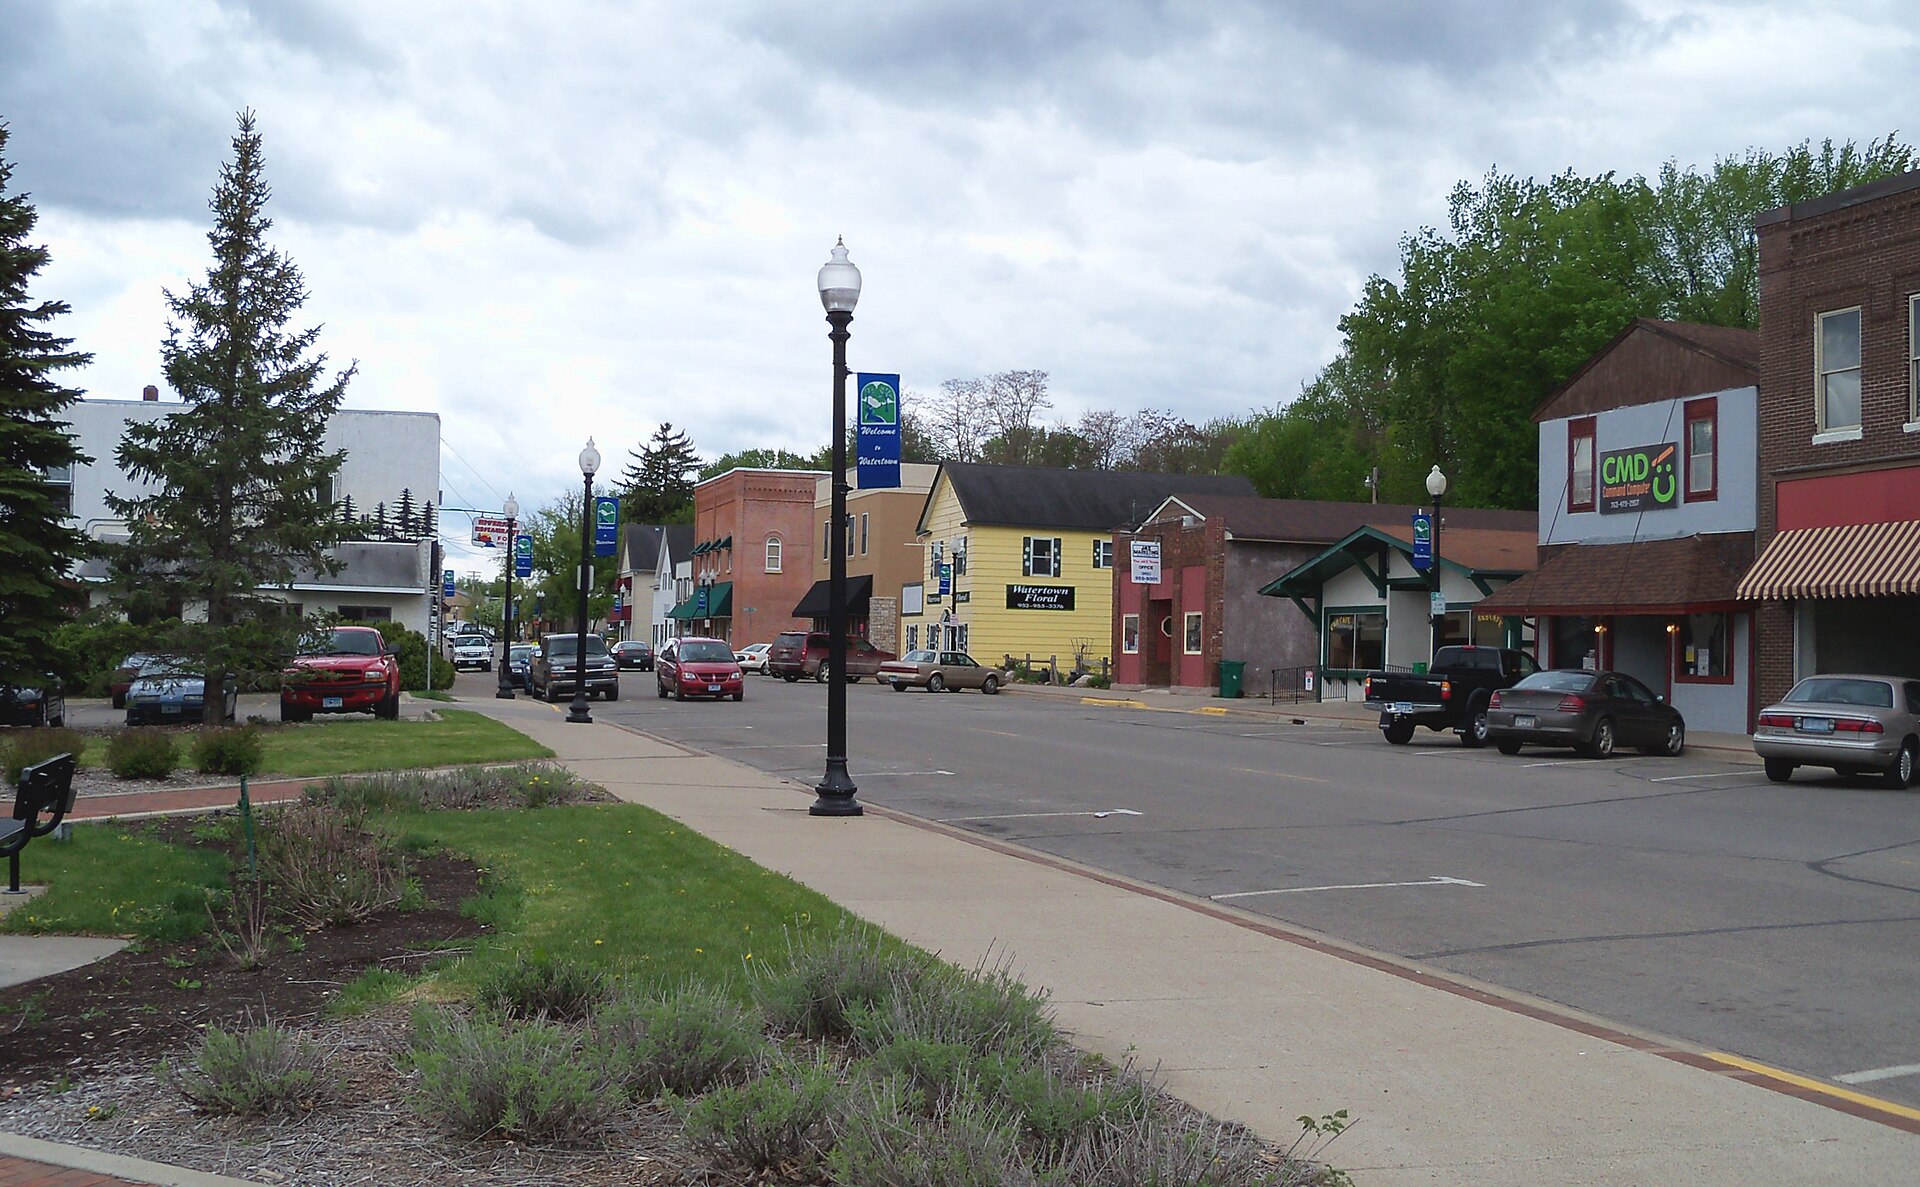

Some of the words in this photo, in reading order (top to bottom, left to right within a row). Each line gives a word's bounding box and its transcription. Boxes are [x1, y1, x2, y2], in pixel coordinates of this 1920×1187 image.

[860, 426, 896, 435] Welcome
[858, 456, 898, 466] Watertown
[1602, 453, 1649, 484] CMD
[1013, 585, 1069, 595] Watertown
[1024, 594, 1058, 603] Floral
